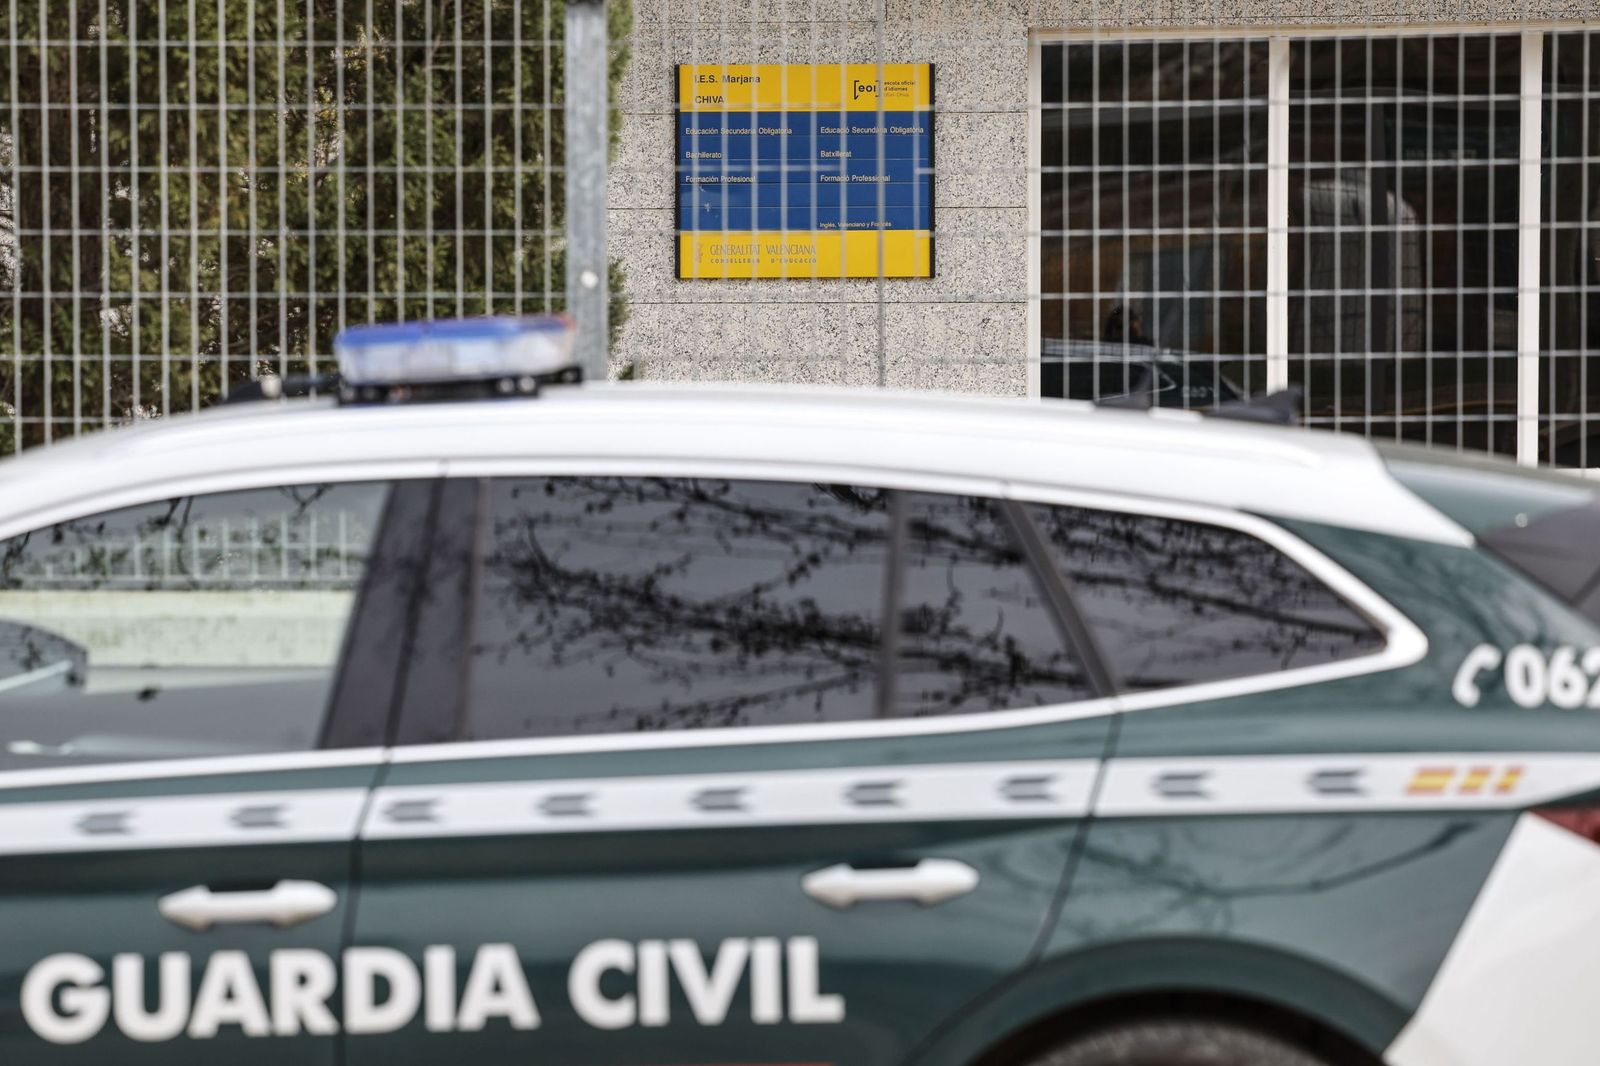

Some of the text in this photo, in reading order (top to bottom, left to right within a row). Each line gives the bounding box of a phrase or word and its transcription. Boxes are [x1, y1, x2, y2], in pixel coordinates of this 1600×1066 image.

[694, 75, 761, 85] I.E.S. Marjana
[695, 96, 724, 104] CHIVA
[685, 127, 792, 136] Educación Secundaria Obligatoria
[685, 151, 722, 159] Bachillerato
[820, 150, 851, 158] Batxillerat
[851, 174, 891, 182] Professional
[709, 244, 816, 255] GENERALITAT VALENCIANA
[19, 935, 846, 1045] GUARDIA CIVIL
